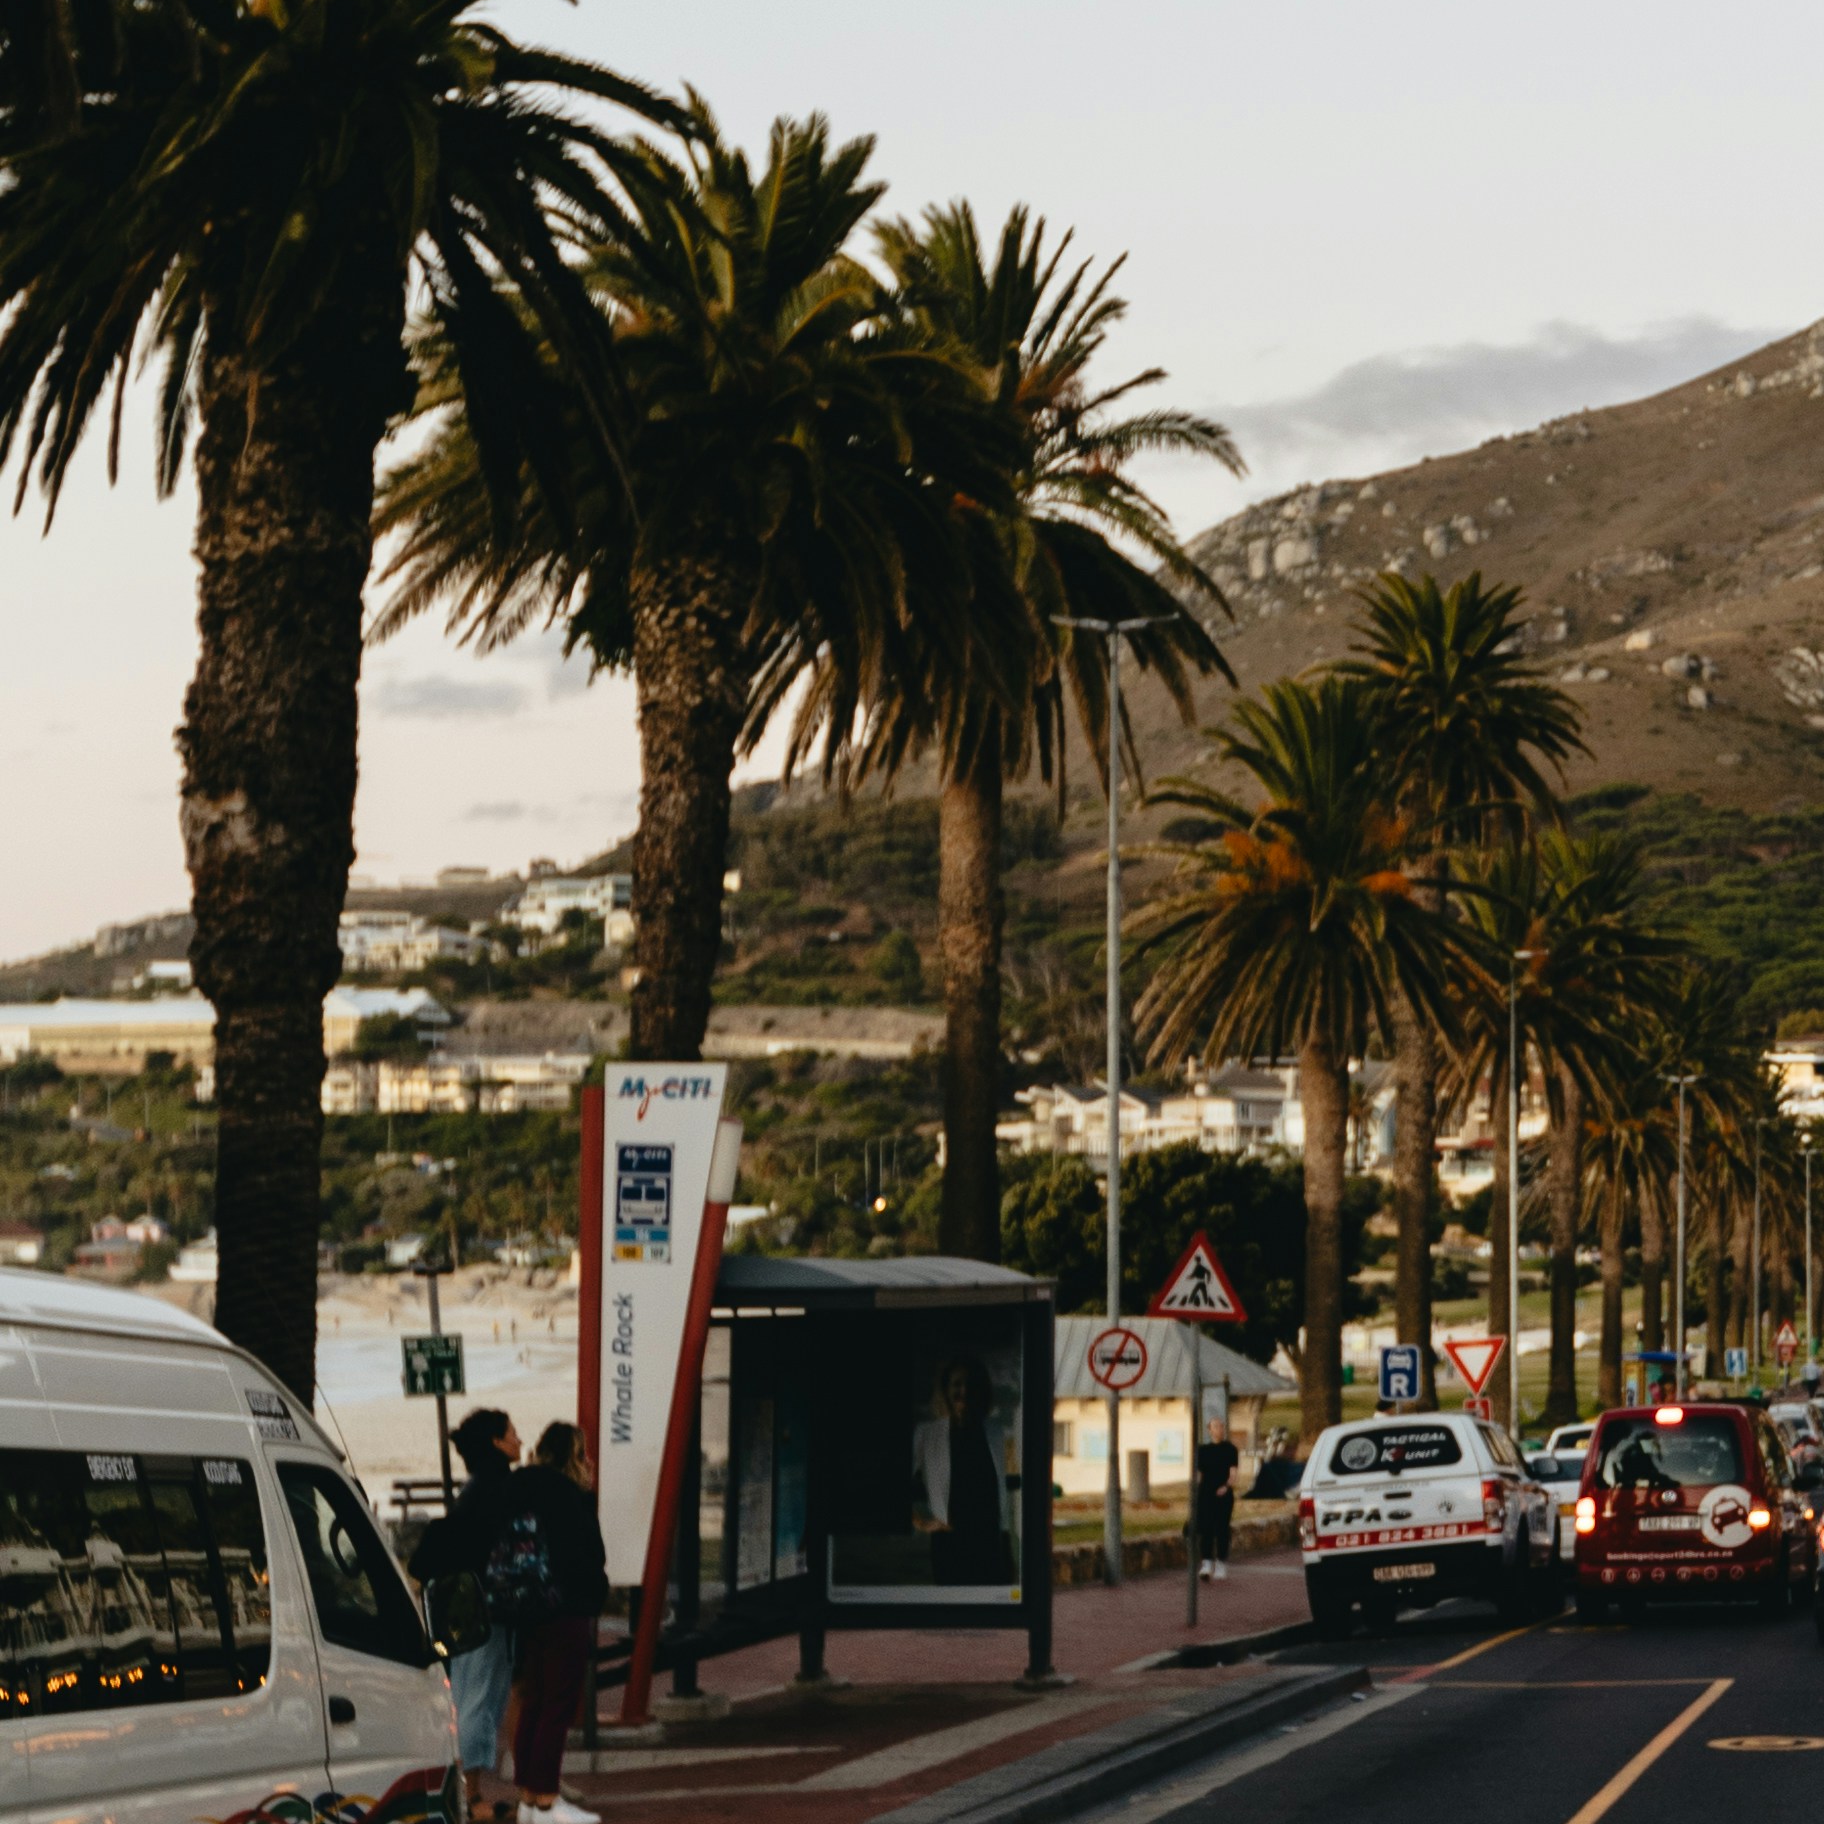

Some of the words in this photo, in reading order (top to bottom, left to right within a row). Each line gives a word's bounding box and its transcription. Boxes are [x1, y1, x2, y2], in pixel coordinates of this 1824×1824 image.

[611, 1294, 633, 1356] Rock
[1390, 1373, 1409, 1396] R
[611, 1363, 633, 1445] Whale
[1383, 1432, 1446, 1445] TACTICAL
[1322, 1509, 1382, 1526] PPA
[1336, 1532, 1370, 1547] 021
